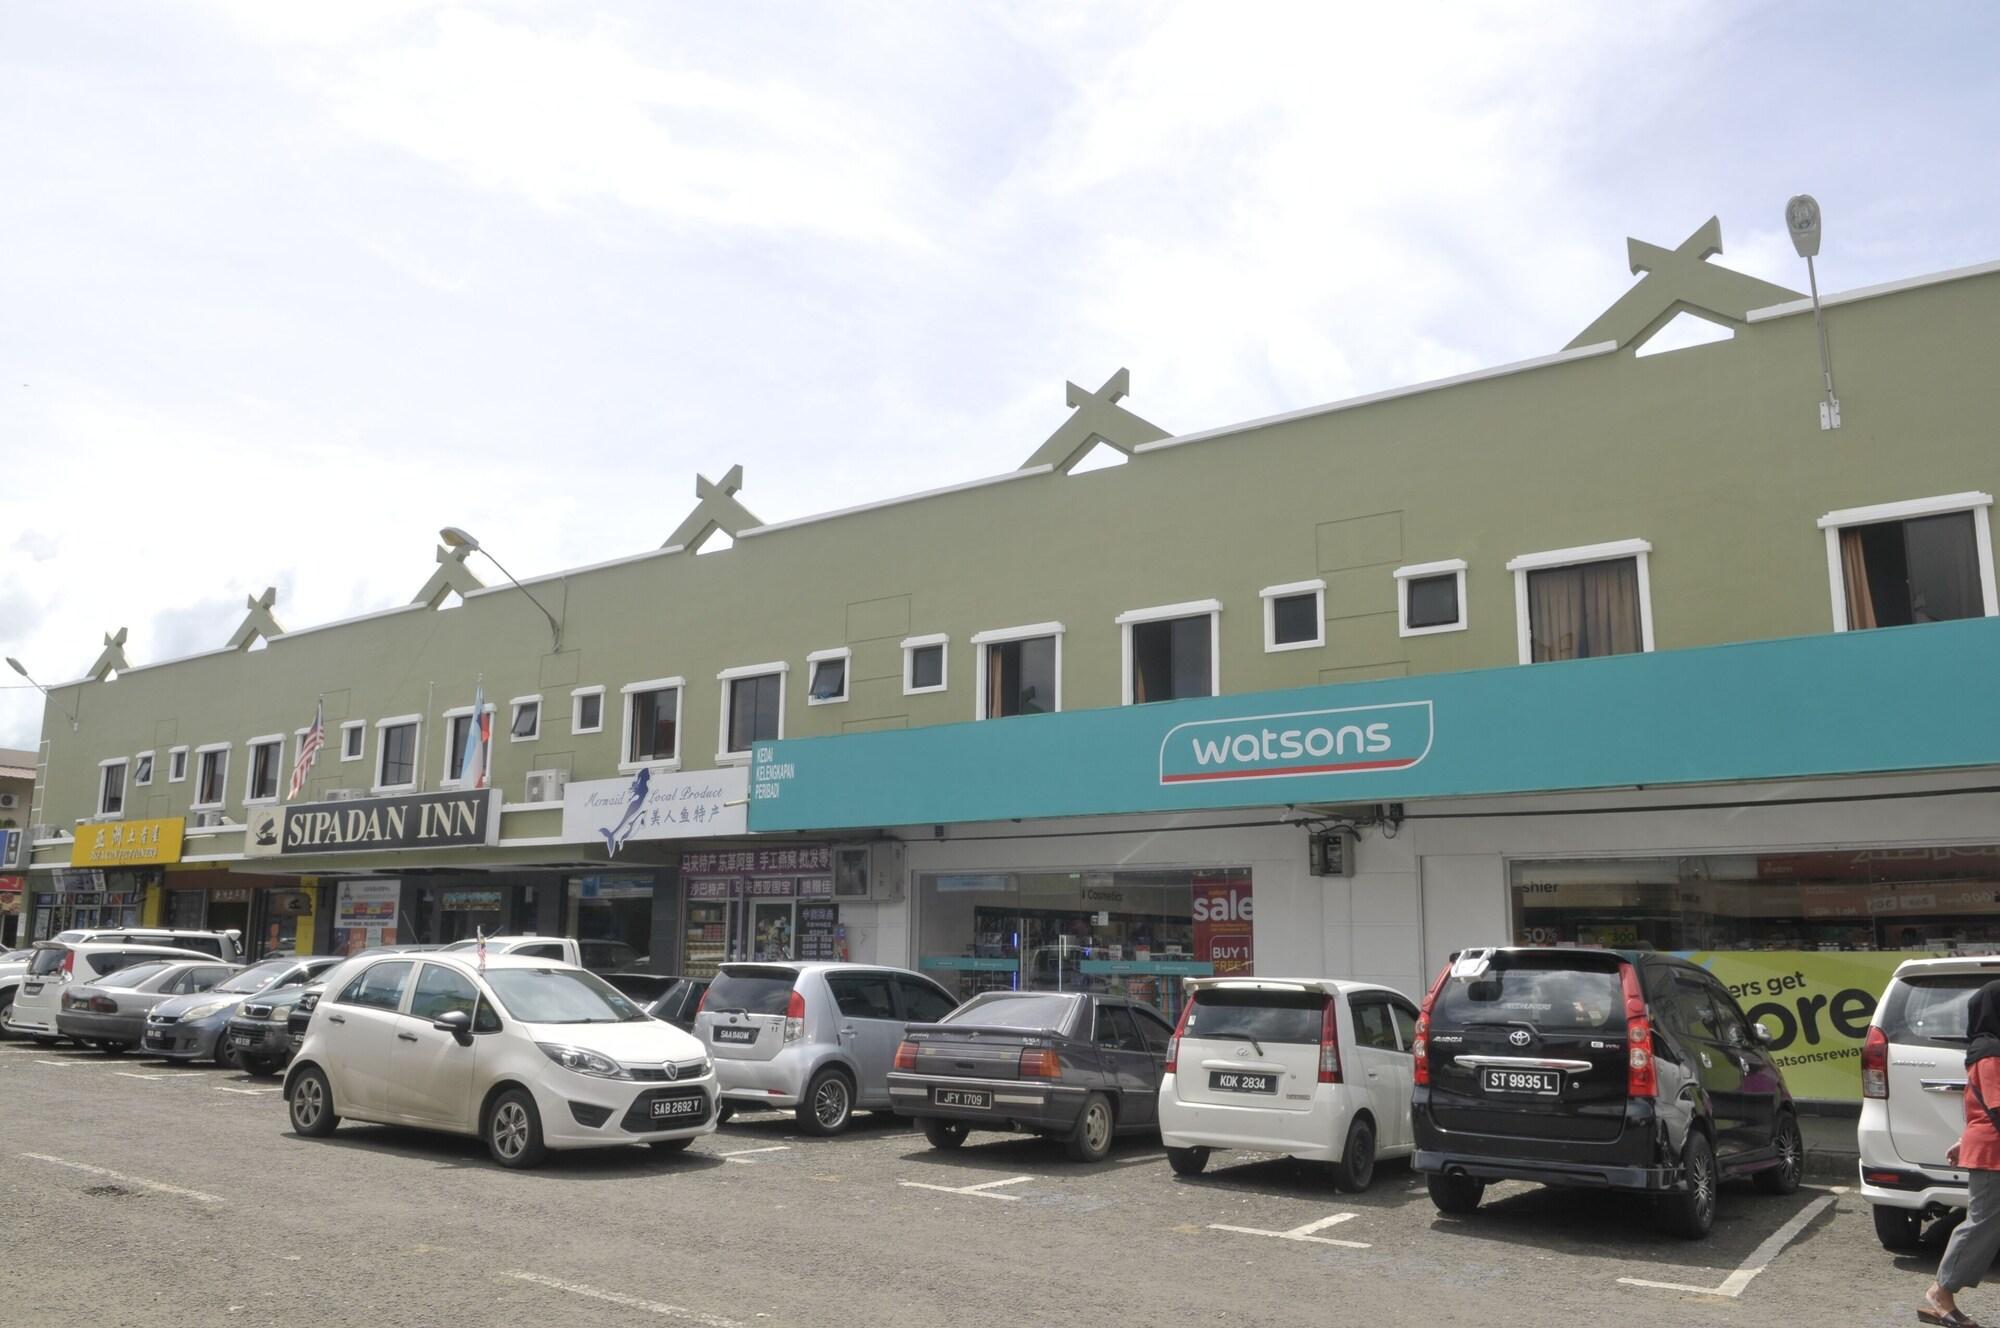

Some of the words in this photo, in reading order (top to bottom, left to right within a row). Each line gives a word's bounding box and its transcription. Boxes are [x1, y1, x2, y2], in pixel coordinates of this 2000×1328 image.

[1193, 722, 1392, 765] watsons
[756, 748, 774, 763] KEDAI
[756, 764, 795, 780] KELENGKAPAN
[648, 786, 677, 804] Local
[679, 786, 724, 801] Product
[755, 783, 780, 799] PERIBADI
[287, 804, 408, 847] SIPADAN
[417, 799, 481, 839] INN
[650, 805, 721, 825] 美人鱼特产
[799, 849, 833, 869] 批发零
[1193, 889, 1254, 921] sale
[1213, 946, 1240, 959] BUY
[1243, 946, 1249, 959] 1
[1728, 981, 1762, 998] ers
[1767, 971, 1807, 996] get
[1746, 988, 1878, 1052] ore
[1775, 1046, 1864, 1068] atsonsrewa
[1220, 1074, 1239, 1087] KDK
[1242, 1076, 1266, 1089] 2834
[1491, 1073, 1507, 1087] ST
[1509, 1073, 1541, 1089] 9935
[1543, 1076, 1552, 1089] L
[654, 1102, 671, 1114] SAB
[672, 1100, 692, 1113] 2692
[693, 1100, 699, 1111] Y
[944, 1093, 960, 1103] JFY
[964, 1094, 983, 1105] 1709
